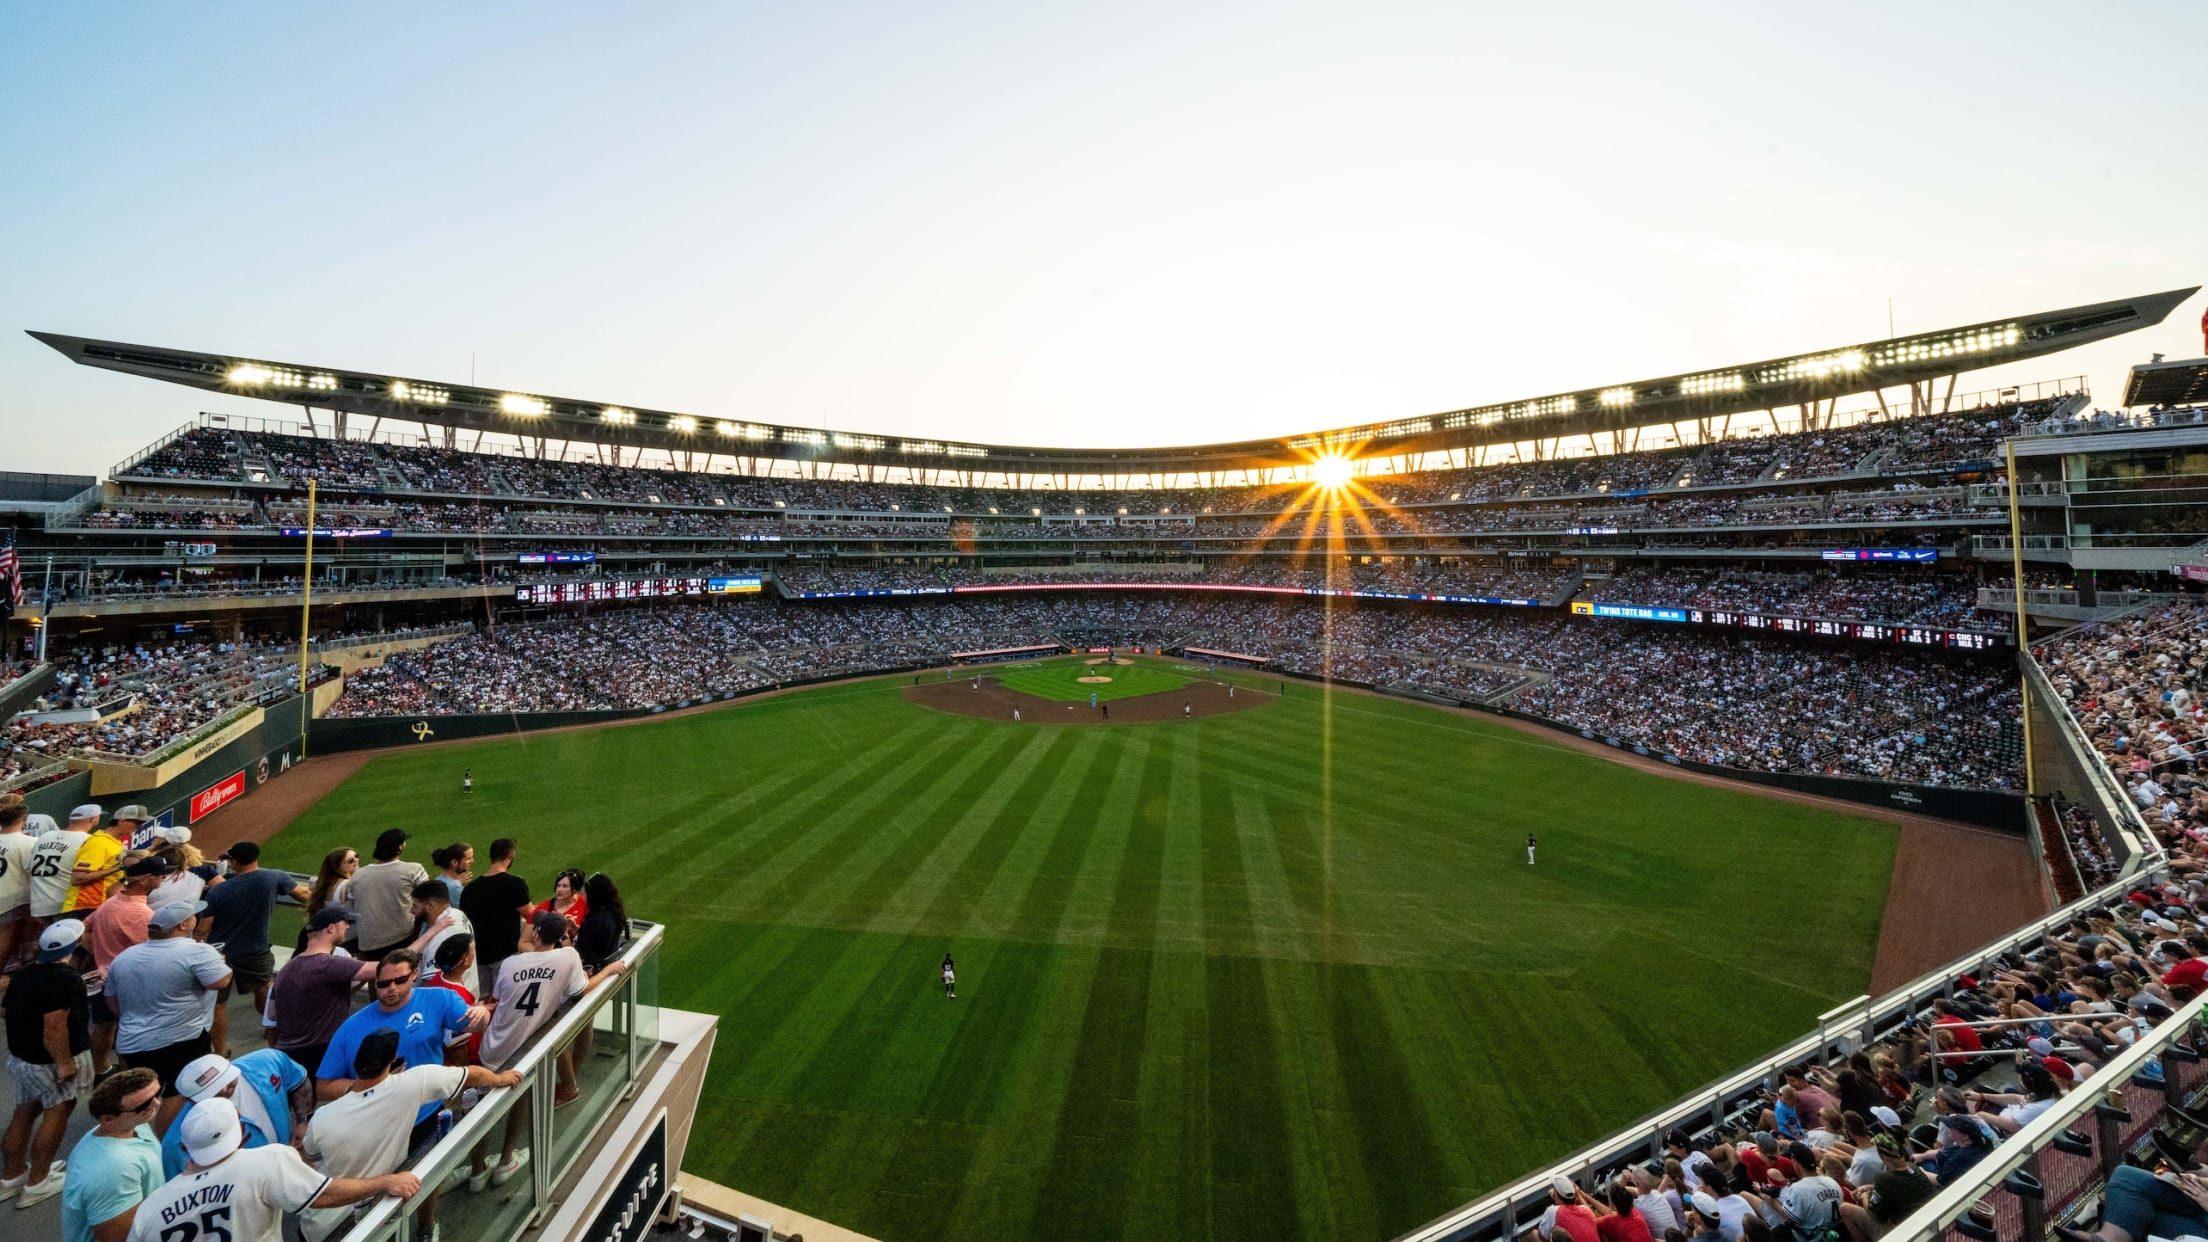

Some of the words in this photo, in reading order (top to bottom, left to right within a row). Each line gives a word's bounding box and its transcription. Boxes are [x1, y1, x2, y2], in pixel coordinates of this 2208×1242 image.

[1599, 606, 1620, 615] TWINS
[1621, 608, 1638, 616] TOTE
[1638, 609, 1653, 617] BAG
[1958, 640, 1973, 648] MIA
[200, 787, 221, 813] Bally
[220, 782, 237, 799] SPORTS
[1890, 794, 1922, 804] GREEN
[38, 841, 70, 853] BUXTON
[31, 854, 62, 877] 25
[513, 966, 556, 983] CORREA
[515, 981, 541, 1017] 4
[1817, 1189, 1839, 1202] CORREA
[161, 1184, 234, 1225] BUXTON
